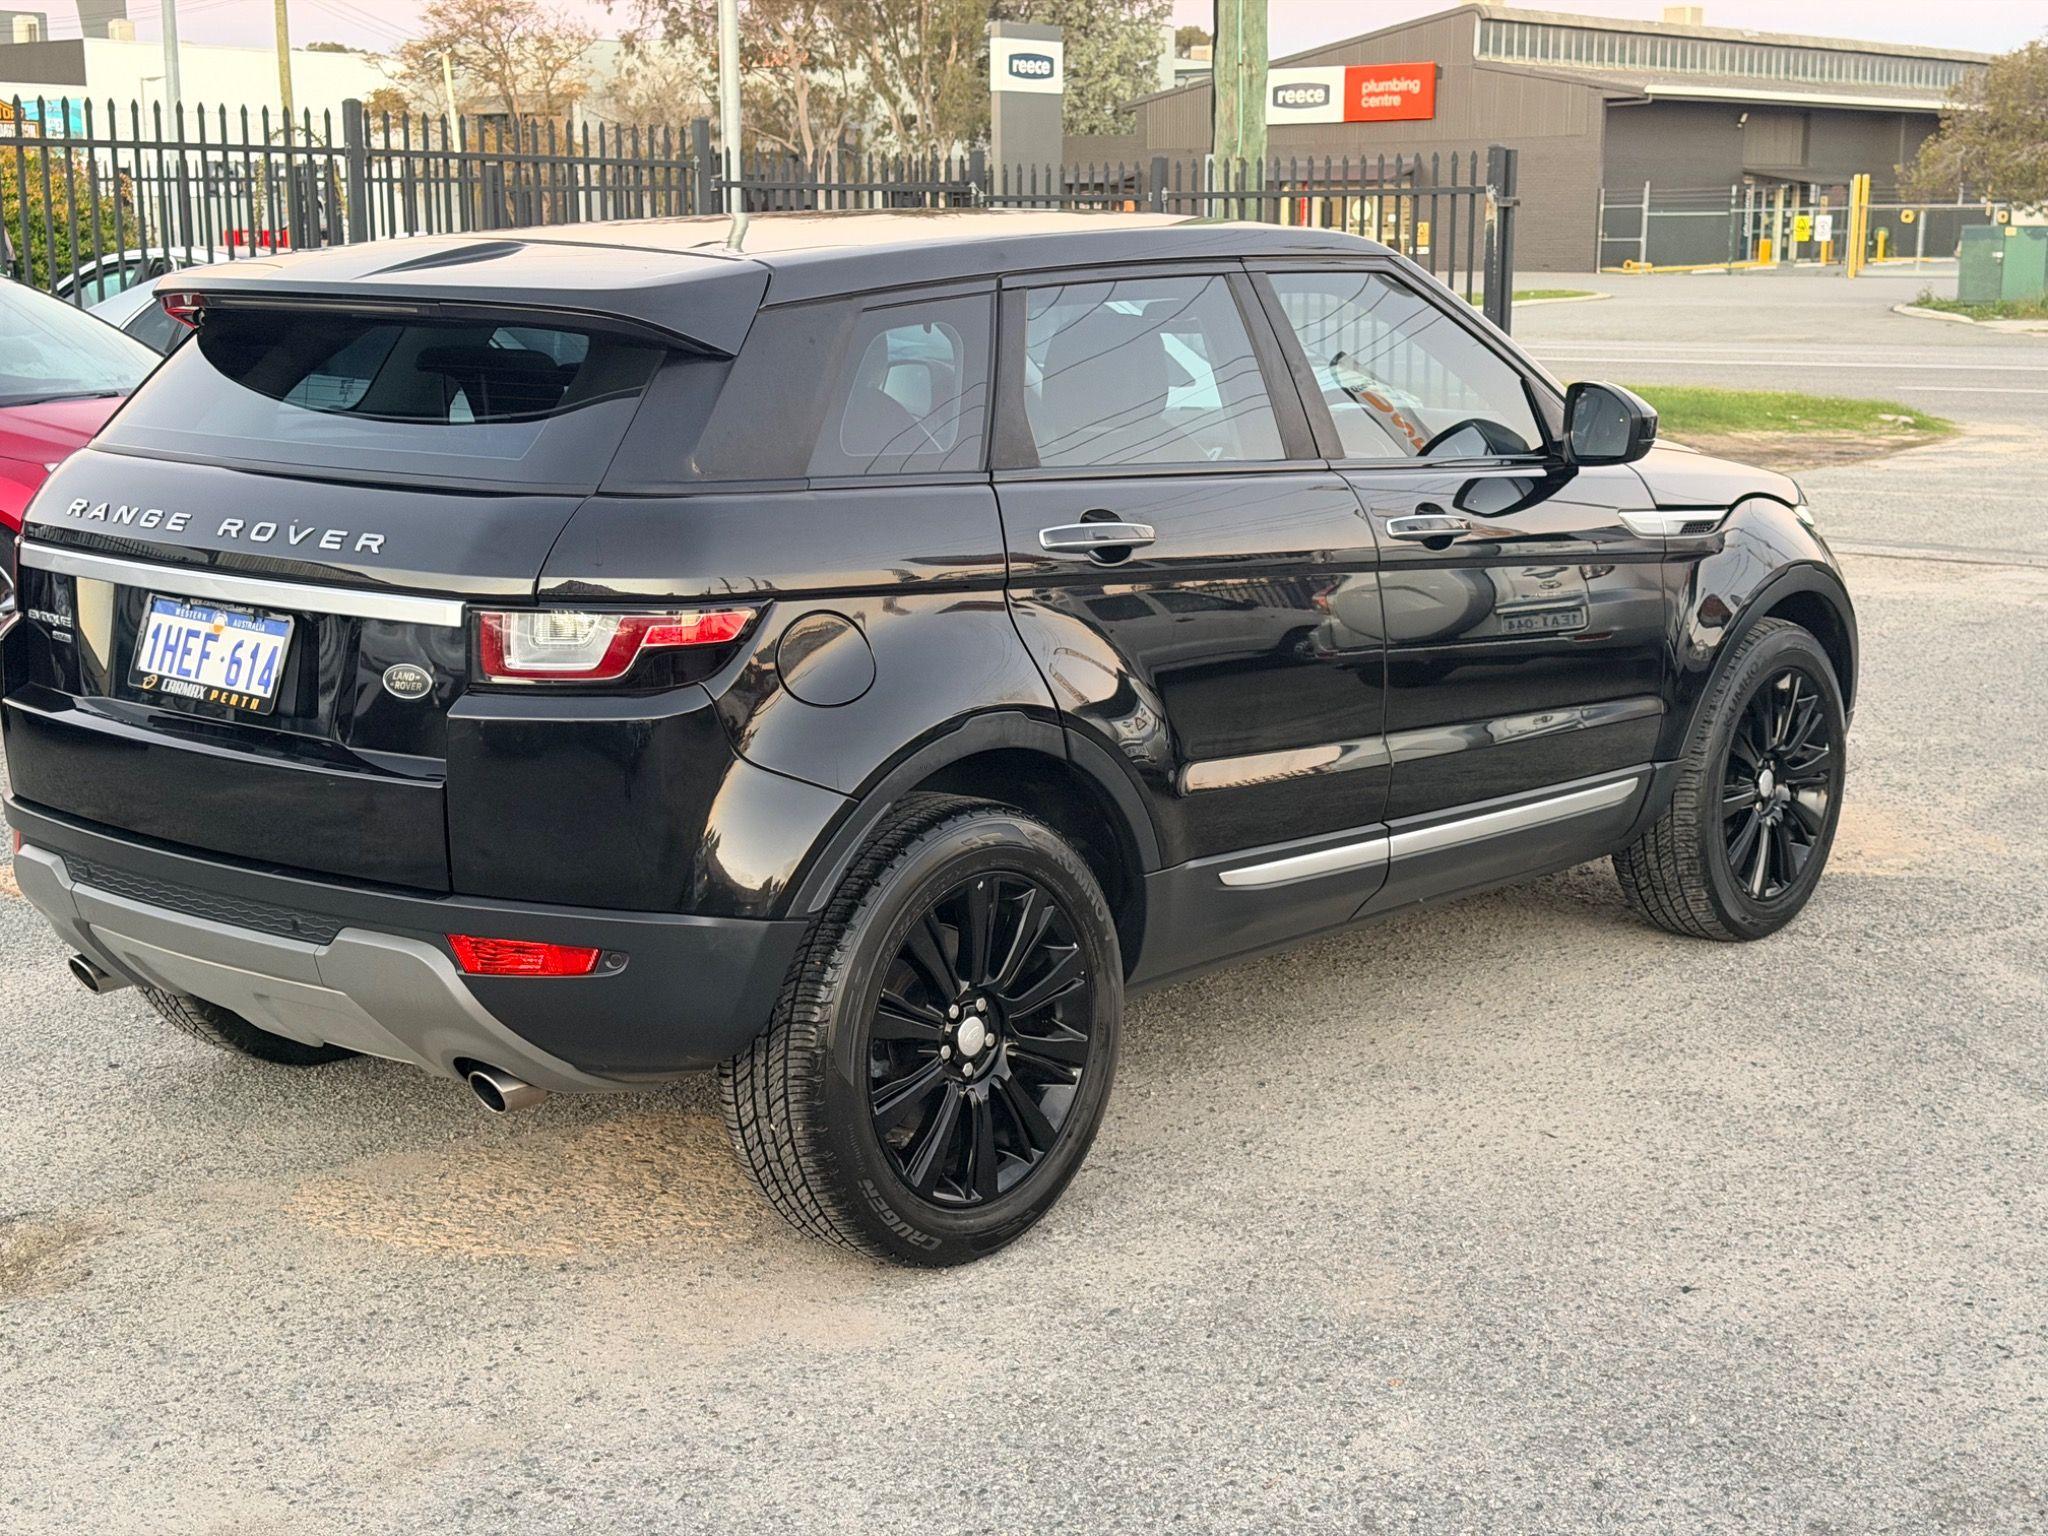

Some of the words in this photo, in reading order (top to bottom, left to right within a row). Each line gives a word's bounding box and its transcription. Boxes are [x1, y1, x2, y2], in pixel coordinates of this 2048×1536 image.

[1012, 59, 1050, 75] reece
[1277, 88, 1325, 104] reece
[1361, 77, 1421, 96] plumbing
[1361, 94, 1402, 108] centre
[66, 498, 192, 532] RANGE
[216, 518, 385, 554] ROVER
[175, 608, 207, 621] WESTERN
[233, 619, 266, 632] AUSTRALIA
[160, 678, 208, 700] CARMAX
[209, 689, 260, 711] PERTH
[857, 1179, 942, 1250] CRUGEN
